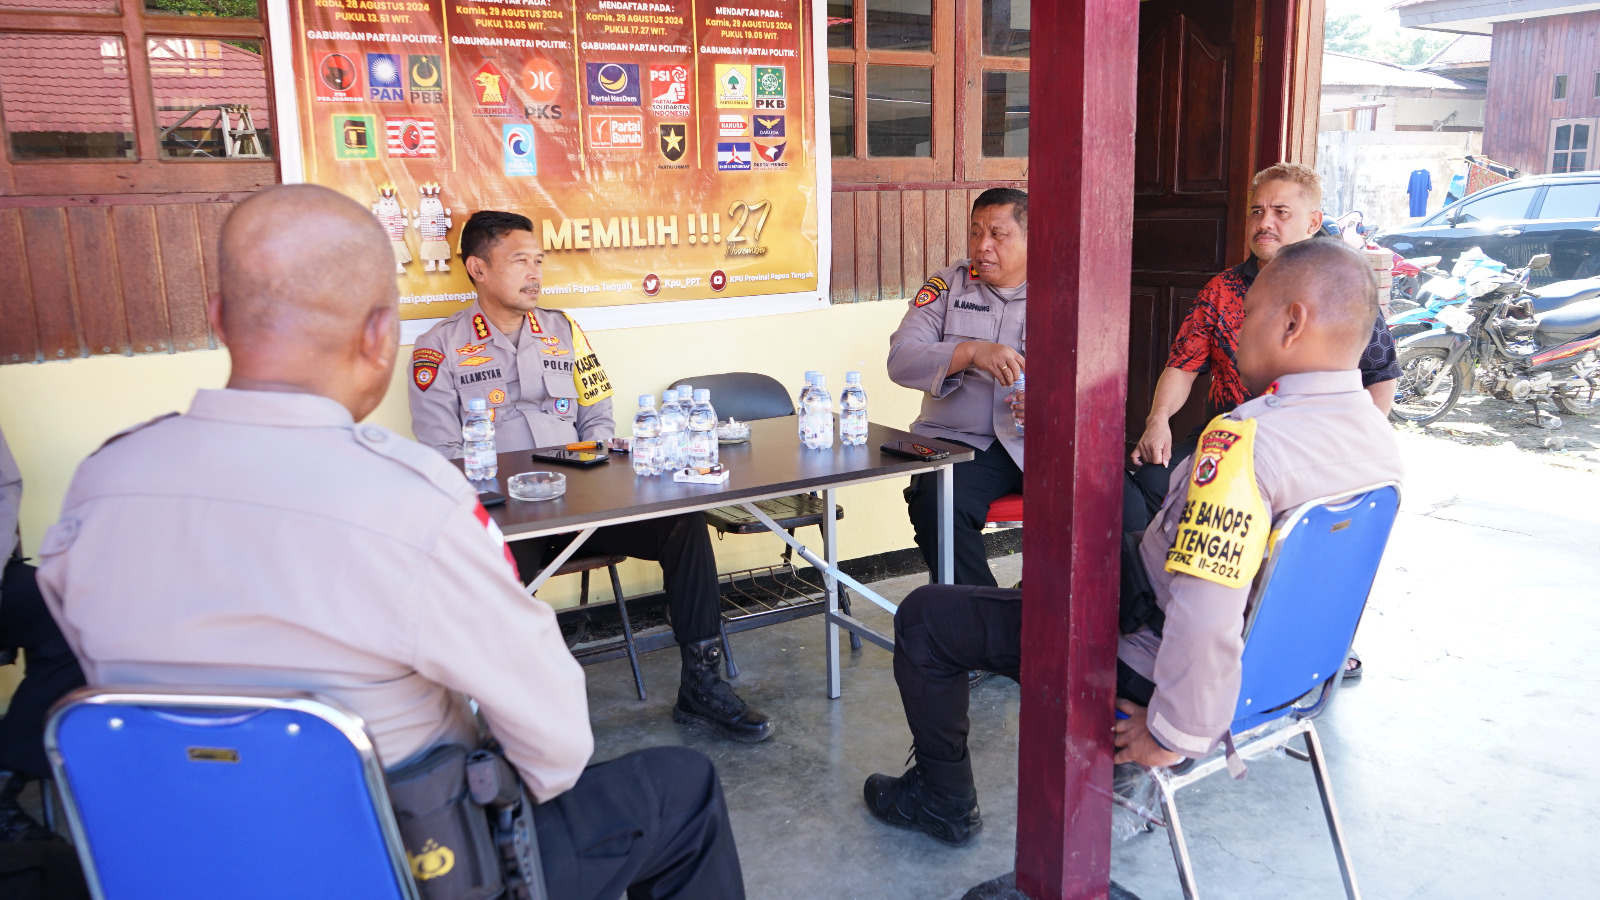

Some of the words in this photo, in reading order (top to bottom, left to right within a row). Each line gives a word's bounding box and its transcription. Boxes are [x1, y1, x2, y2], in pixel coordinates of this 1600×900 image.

[360, 0, 405, 10] AGUSTUS
[406, 3, 431, 12] 2024
[456, 5, 489, 16] Kamis,
[489, 7, 500, 16] 29
[501, 8, 541, 18] AGUSTUS
[542, 10, 564, 19] 2024
[599, 1, 648, 11] MENDAFTAR
[649, 3, 671, 12] PADA
[335, 12, 366, 22] PUKUL
[367, 14, 390, 23] 13.51
[391, 15, 413, 24] WIT.
[715, 7, 759, 17] MENDAFTAR
[760, 10, 780, 18] PADA
[475, 19, 504, 29] PUKUL
[505, 20, 526, 29] 13.05
[527, 22, 547, 30] WIT.
[586, 13, 615, 22] Kamis,
[616, 14, 626, 22] 29
[627, 15, 664, 24] AGUSTUS
[664, 16, 684, 25] 2024
[705, 18, 732, 27] Kamis,
[732, 19, 741, 27] 29
[742, 20, 775, 29] AGUSTUS
[776, 22, 793, 30] 2024
[604, 25, 630, 34] PUKUL
[631, 26, 650, 35] 17.27
[650, 27, 668, 35] WIT.
[721, 30, 743, 38] PUKUL
[763, 32, 779, 40] WIT.
[307, 30, 365, 41] GABUNGAN
[366, 33, 401, 42] PARTAI
[402, 34, 437, 43] POLITIK
[452, 36, 503, 46] GABUNGAN
[504, 38, 534, 47] PARTAI
[536, 40, 567, 49] POLITIK
[581, 42, 628, 51] GABUNGAN
[629, 43, 657, 52] PARTAI
[659, 44, 687, 53] POLITIK
[700, 46, 742, 55] GABUNGAN
[743, 48, 768, 56] PARTAI
[769, 49, 794, 57] POLITIK
[650, 70, 670, 81] PSI
[370, 88, 404, 101] PAN
[410, 91, 443, 104] PBB
[755, 99, 785, 108] PKB
[472, 107, 513, 115] GERINDRA
[524, 104, 562, 119] PKS
[612, 120, 640, 132] Partai
[612, 132, 641, 144] Buruh
[725, 199, 772, 243] 27
[542, 214, 679, 251] MEMILIH
[687, 212, 722, 245] !!!
[724, 242, 768, 258] November
[729, 275, 744, 283] KPU
[744, 273, 770, 282] Provinsi
[770, 272, 790, 281] Papua
[790, 270, 813, 280] Tengah
[541, 284, 571, 295] rovinsi
[572, 284, 600, 295] Papua
[601, 282, 632, 294] Tengah
[664, 277, 701, 289] Kpu_PPT
[400, 290, 478, 305] nsipapuatengah
[460, 368, 502, 385] ALAMSYAH
[584, 388, 598, 400] OMP
[1196, 501, 1252, 538] BANOPS
[1181, 529, 1244, 566] TENGAH
